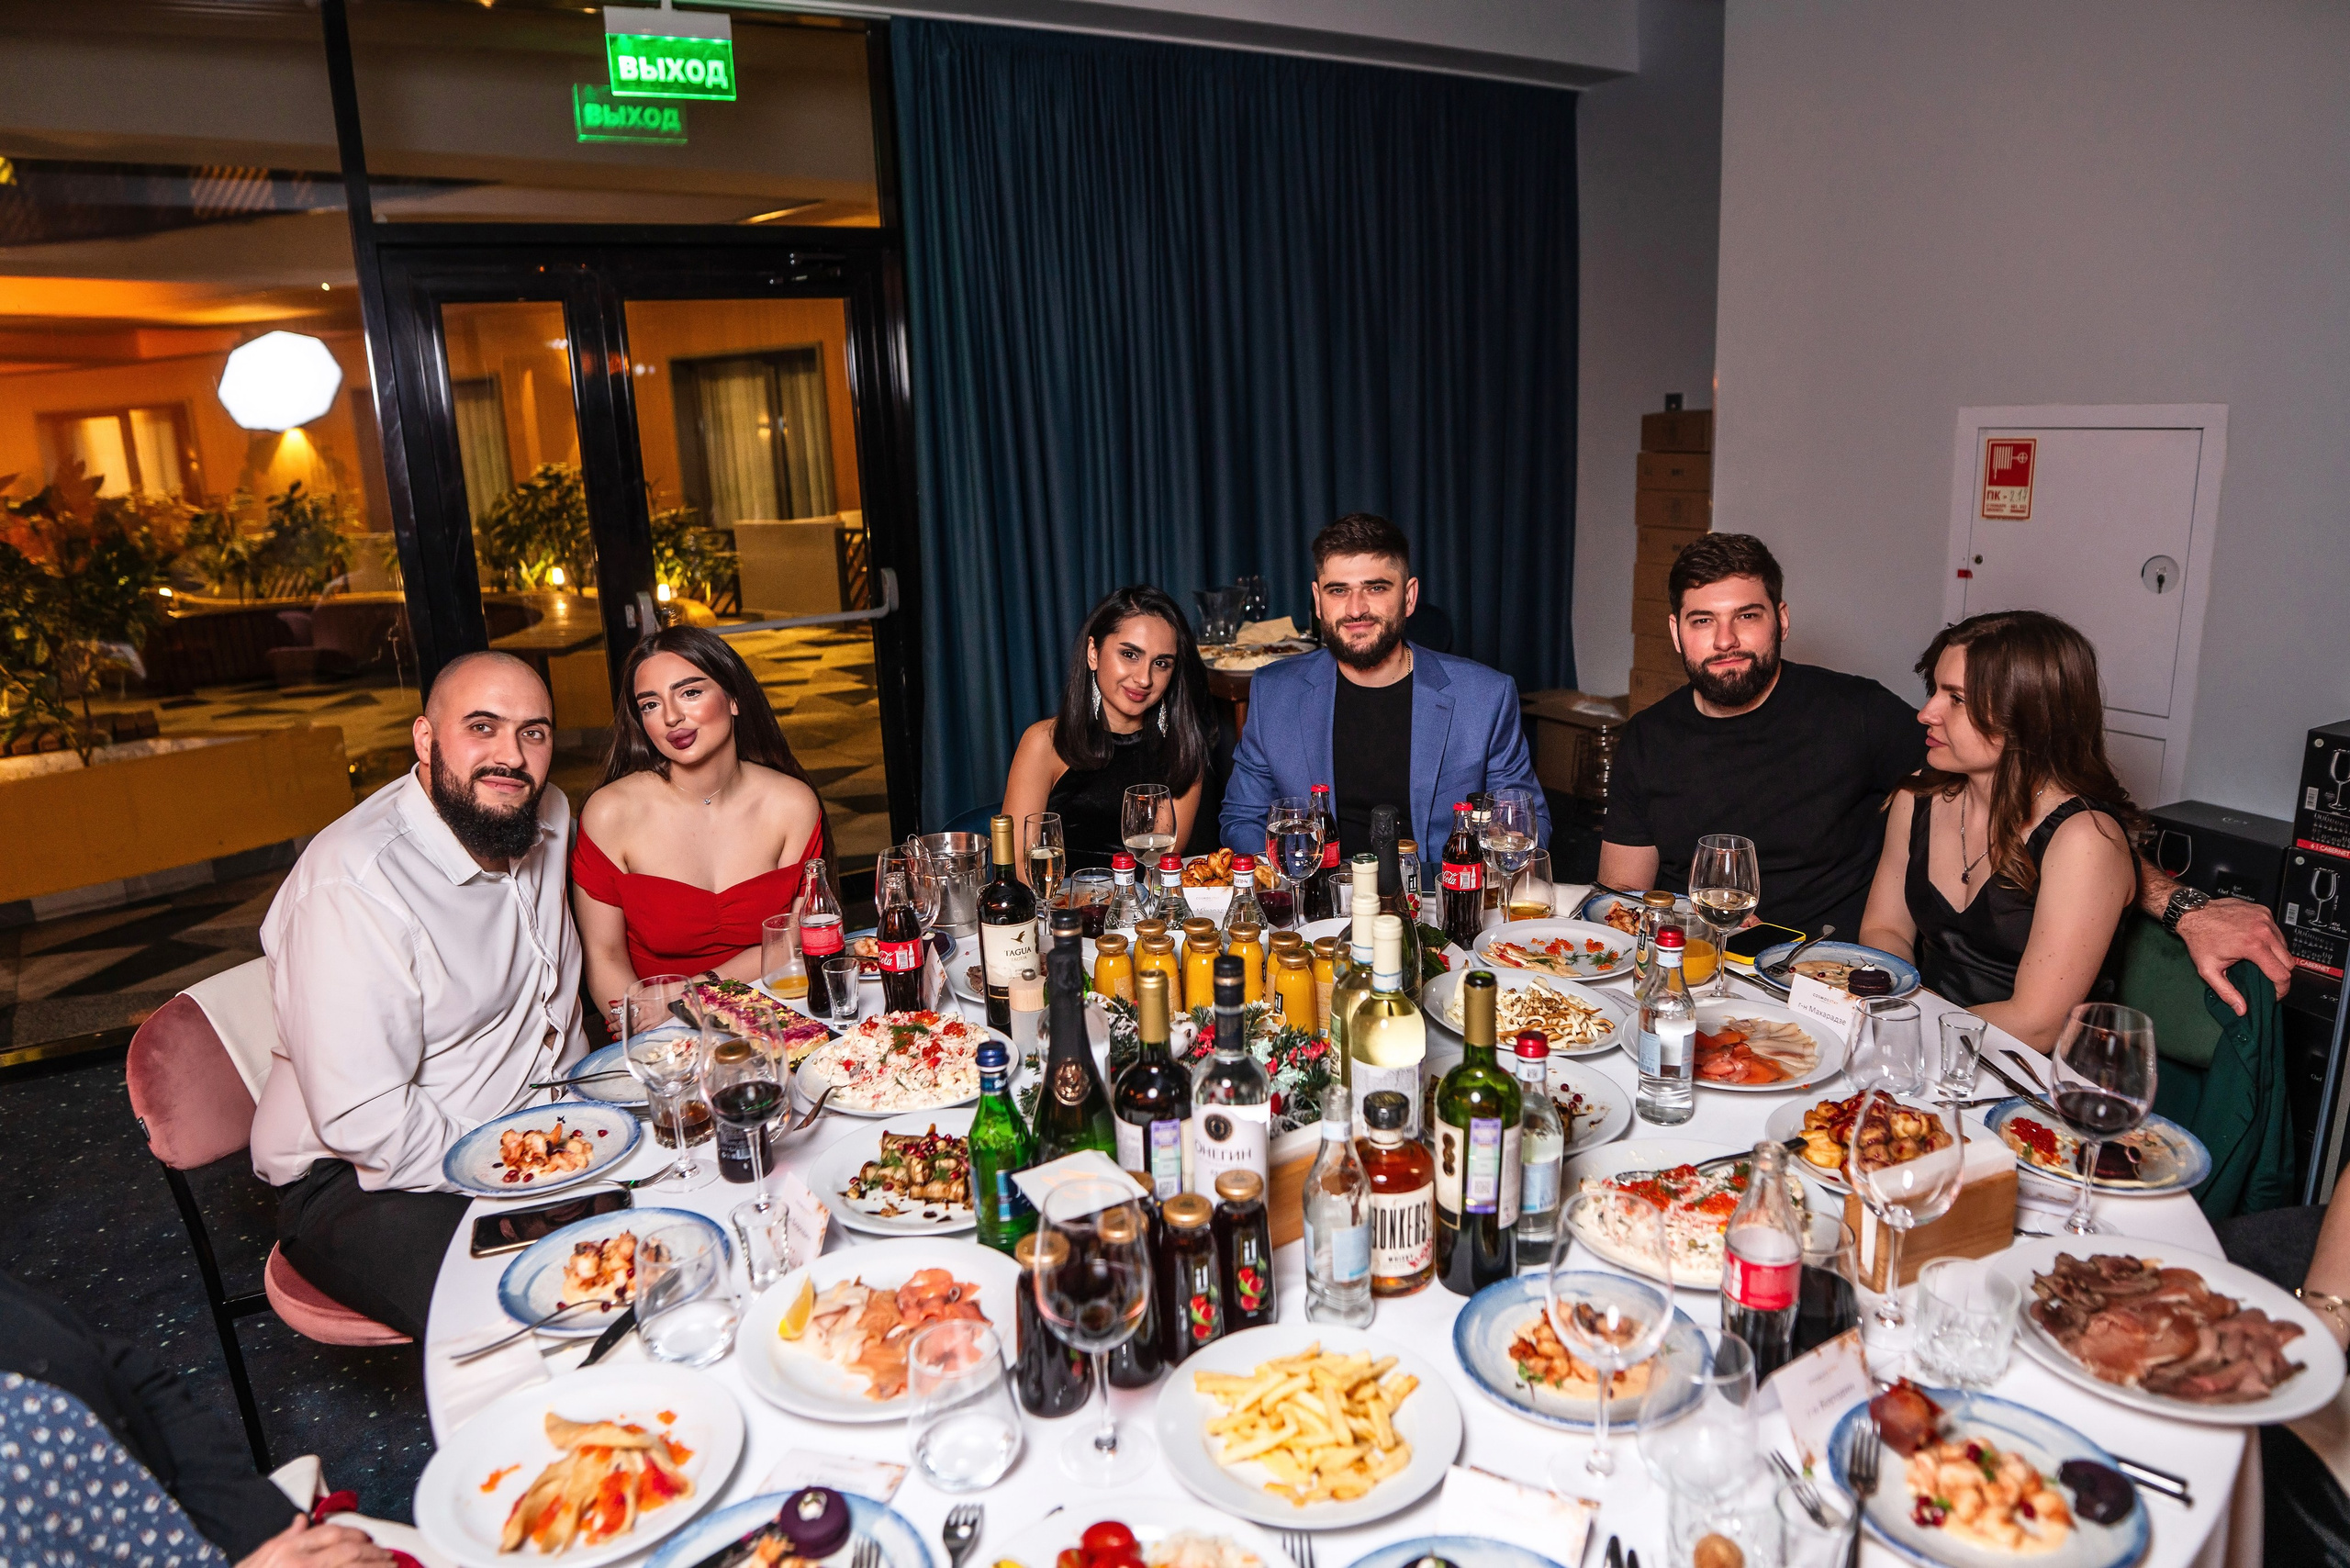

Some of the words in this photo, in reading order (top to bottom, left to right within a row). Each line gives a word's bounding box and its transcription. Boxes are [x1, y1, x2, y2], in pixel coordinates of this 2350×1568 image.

[618, 55, 729, 89] ВЫХОД
[583, 102, 681, 133] ВЫХОД
[1986, 489, 2001, 501] ПК
[1004, 946, 1032, 957] TAGUA
[1808, 1004, 1847, 1026] Махарадзе
